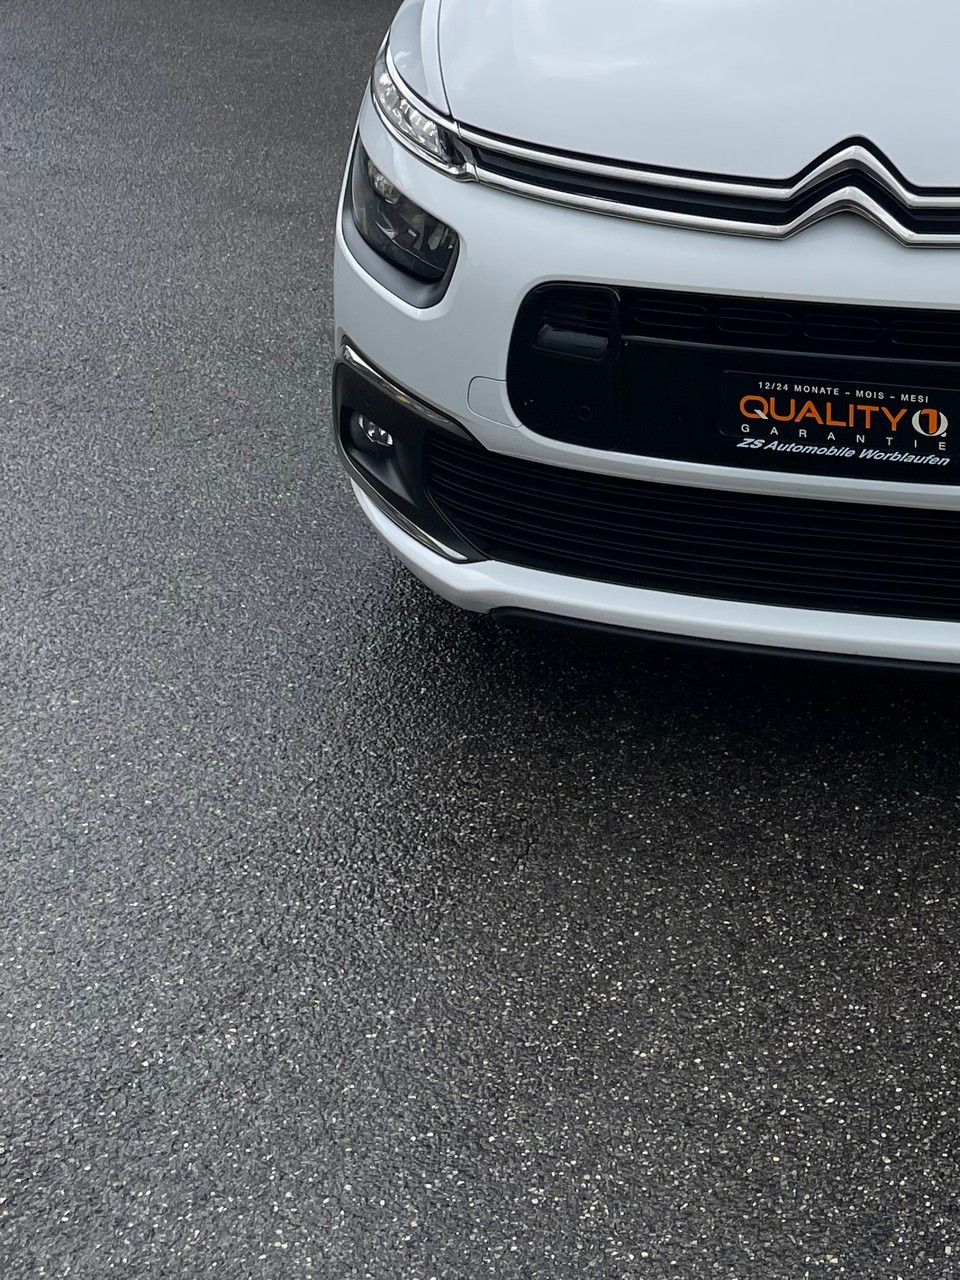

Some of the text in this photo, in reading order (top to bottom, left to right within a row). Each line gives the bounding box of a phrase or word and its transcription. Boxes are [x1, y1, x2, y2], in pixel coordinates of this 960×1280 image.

[758, 381, 789, 392] 12/24
[794, 384, 840, 396] MONATE
[855, 389, 885, 400] MOIS
[900, 393, 929, 404] MESI
[739, 395, 908, 432] QUALITY
[740, 423, 947, 451] GARANTIE
[736, 437, 951, 467] ZS Automobile Worblaufen
